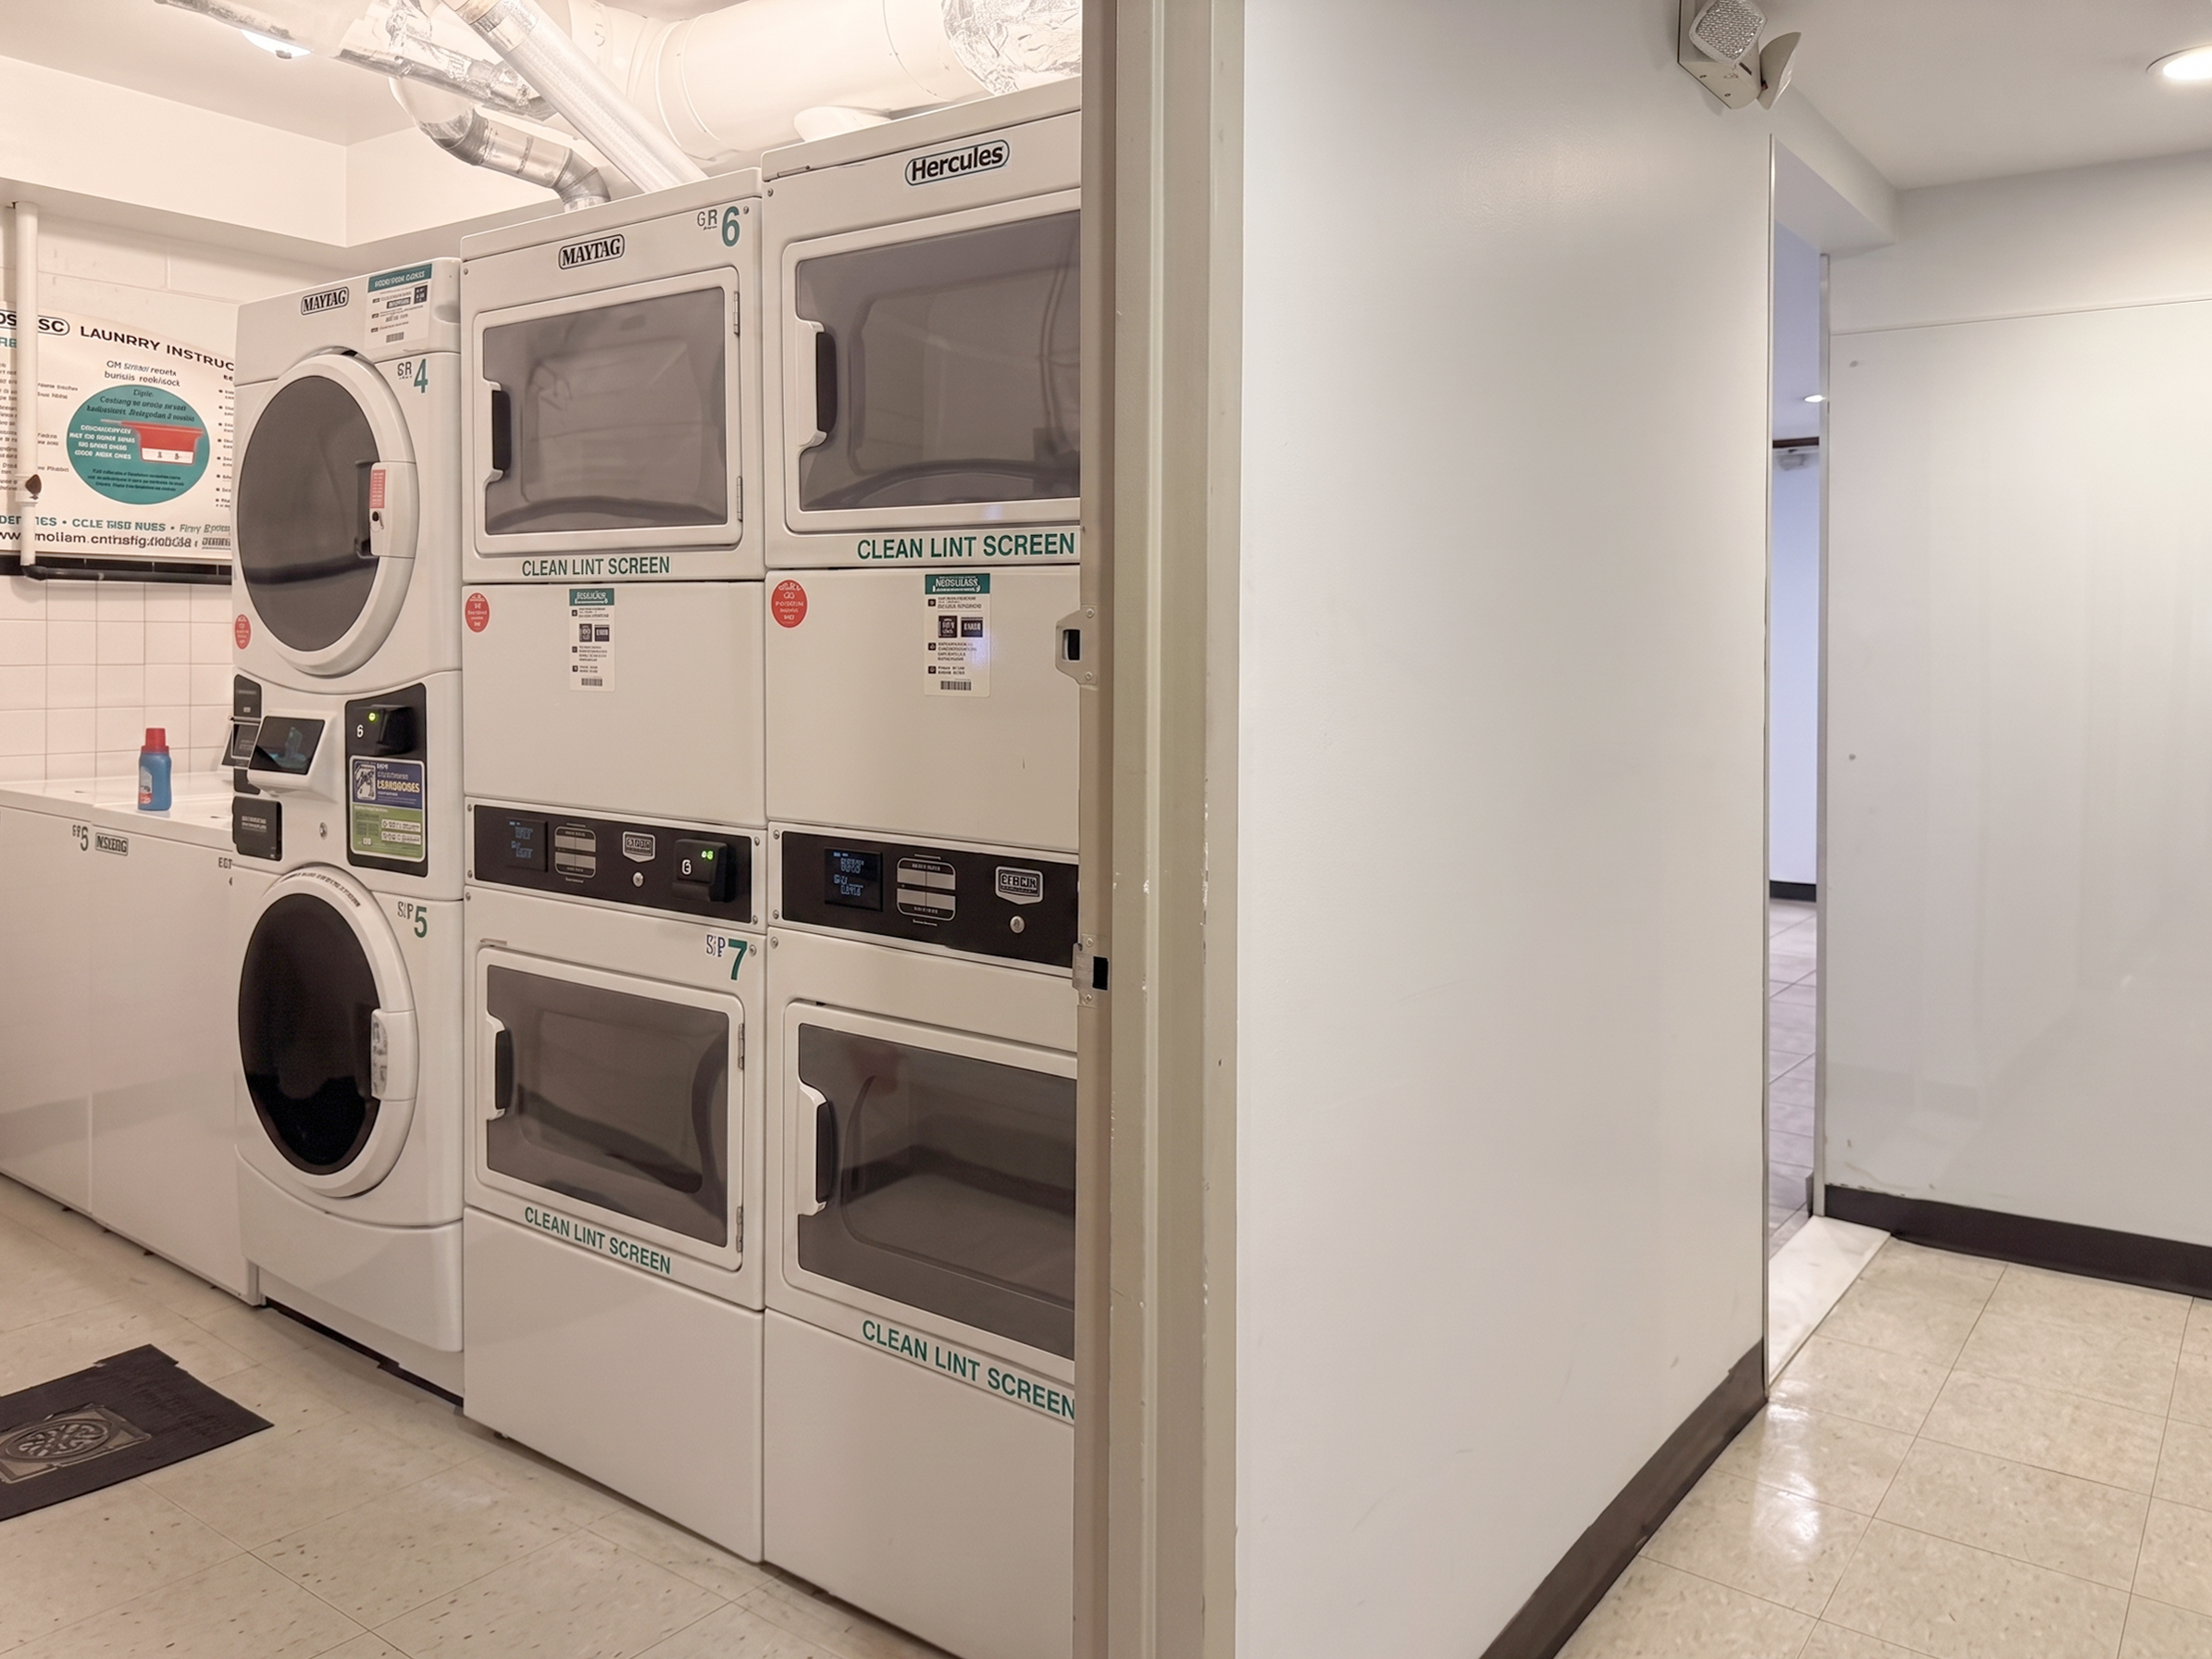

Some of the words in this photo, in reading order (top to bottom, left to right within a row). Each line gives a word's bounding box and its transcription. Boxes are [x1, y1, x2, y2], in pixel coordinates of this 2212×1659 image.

[911, 146, 1004, 181] Hercules
[722, 206, 740, 247] 6
[562, 237, 621, 267] MAYTAG
[303, 288, 347, 313] MAYTAG
[414, 358, 429, 394] 4
[857, 538, 924, 560] CLEAN
[930, 536, 977, 558] LINT
[982, 532, 1075, 556] SCREEN
[521, 559, 568, 577] CLEAN
[572, 558, 604, 576] LINT
[607, 555, 670, 575] SCREEN
[356, 724, 364, 738] 6
[414, 904, 428, 939] 5
[727, 938, 748, 981] 7
[525, 1206, 570, 1238] CLEAN
[574, 1223, 606, 1250] LINT
[609, 1236, 671, 1275] SCREEN
[862, 1319, 927, 1363] CLEAN
[935, 1345, 981, 1382] LINT
[987, 1366, 1075, 1420] SCREEN
